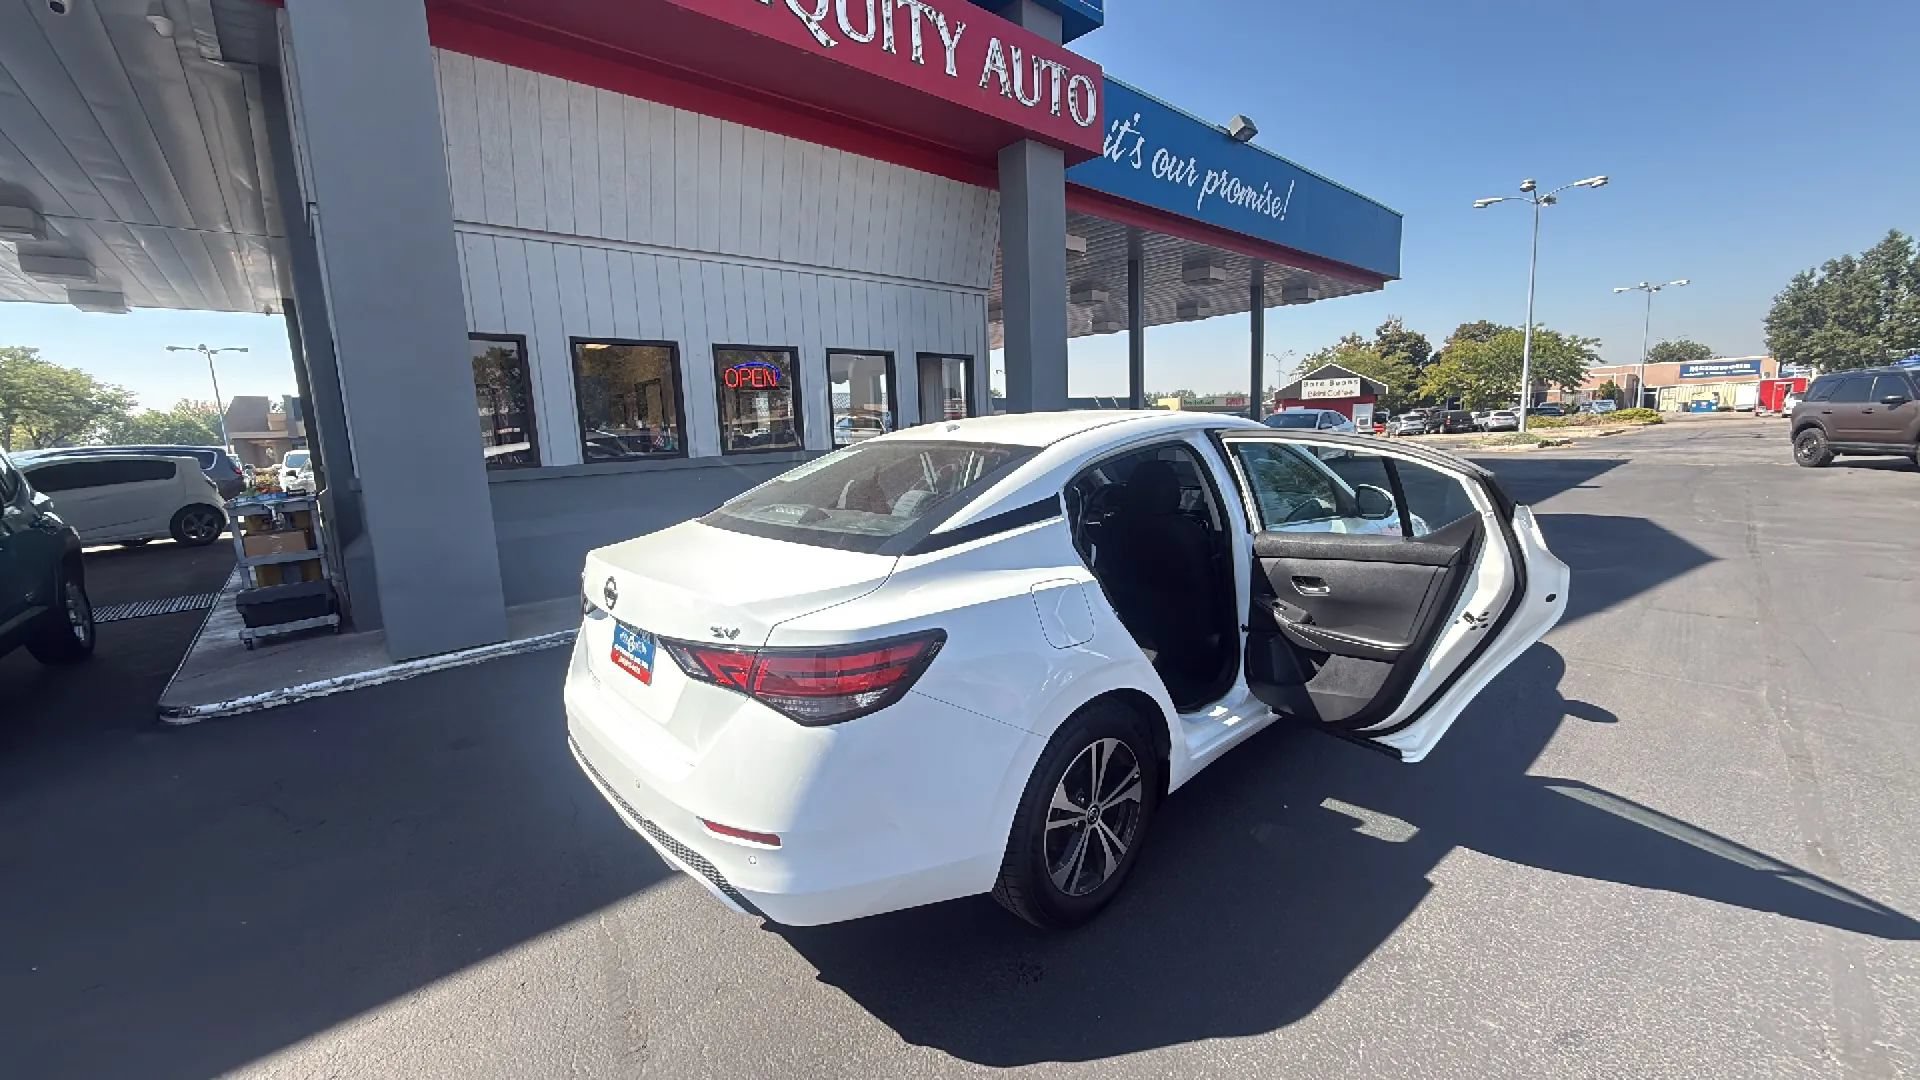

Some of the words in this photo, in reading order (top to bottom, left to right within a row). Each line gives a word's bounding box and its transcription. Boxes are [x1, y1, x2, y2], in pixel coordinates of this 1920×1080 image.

[758, 0, 967, 77] QUITY
[978, 37, 1097, 127] AUTO
[1103, 112, 1145, 169] it's
[1152, 148, 1199, 187] our
[1197, 179, 1295, 221] promise!
[725, 368, 777, 388] OPEN
[710, 626, 740, 640] SV
